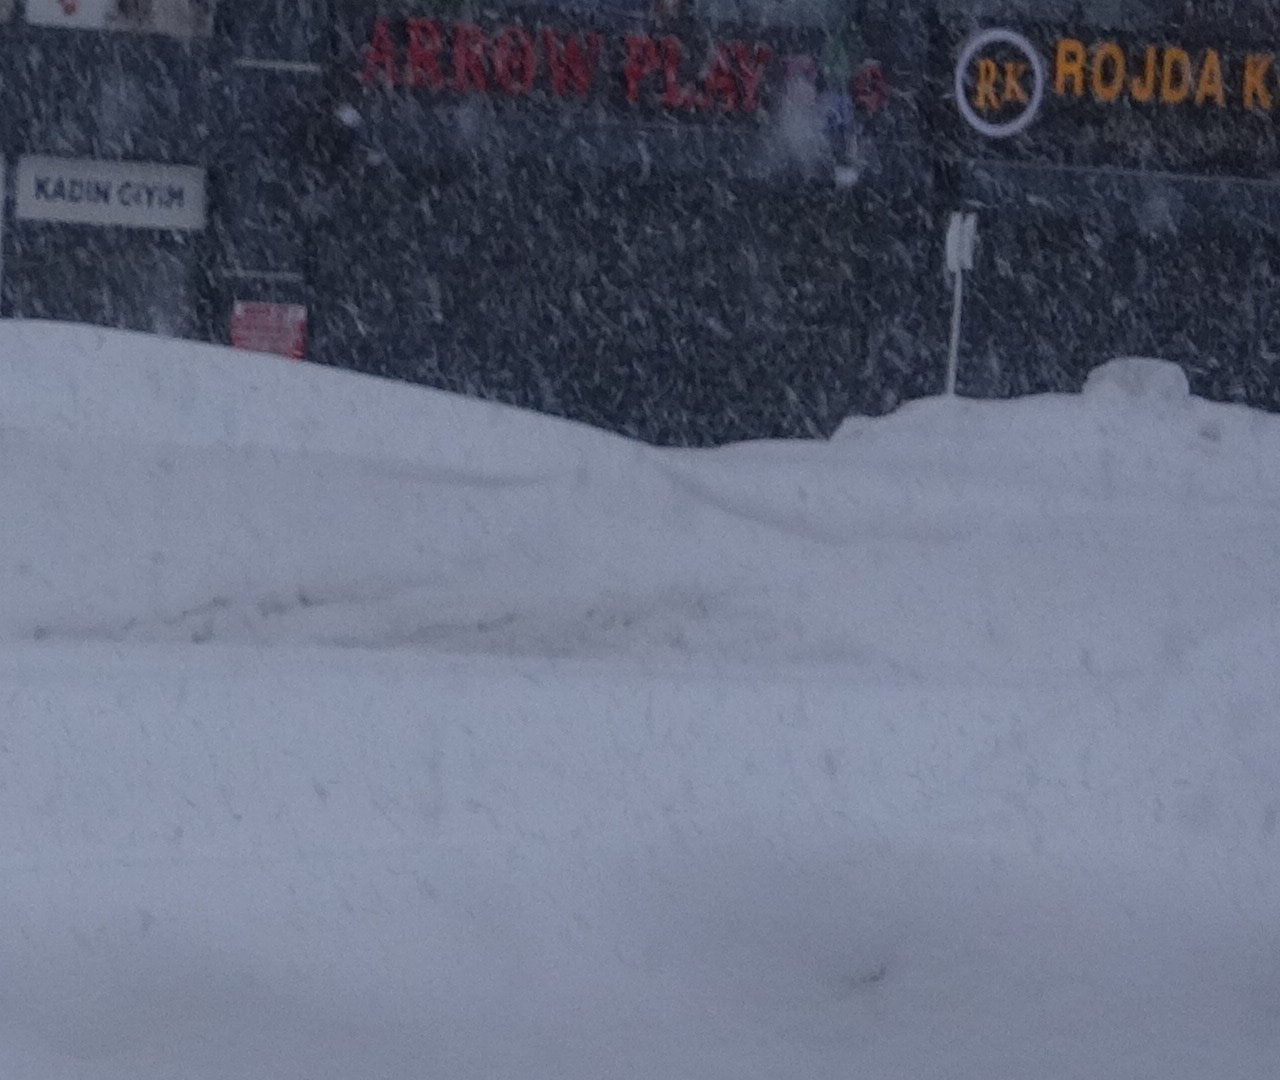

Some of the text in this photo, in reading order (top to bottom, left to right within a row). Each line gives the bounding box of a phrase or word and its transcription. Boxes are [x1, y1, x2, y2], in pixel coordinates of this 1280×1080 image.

[362, 17, 603, 97] ARROW
[624, 32, 772, 112] PLAY
[1053, 37, 1226, 109] ROJDA
[34, 175, 113, 204] KADIN
